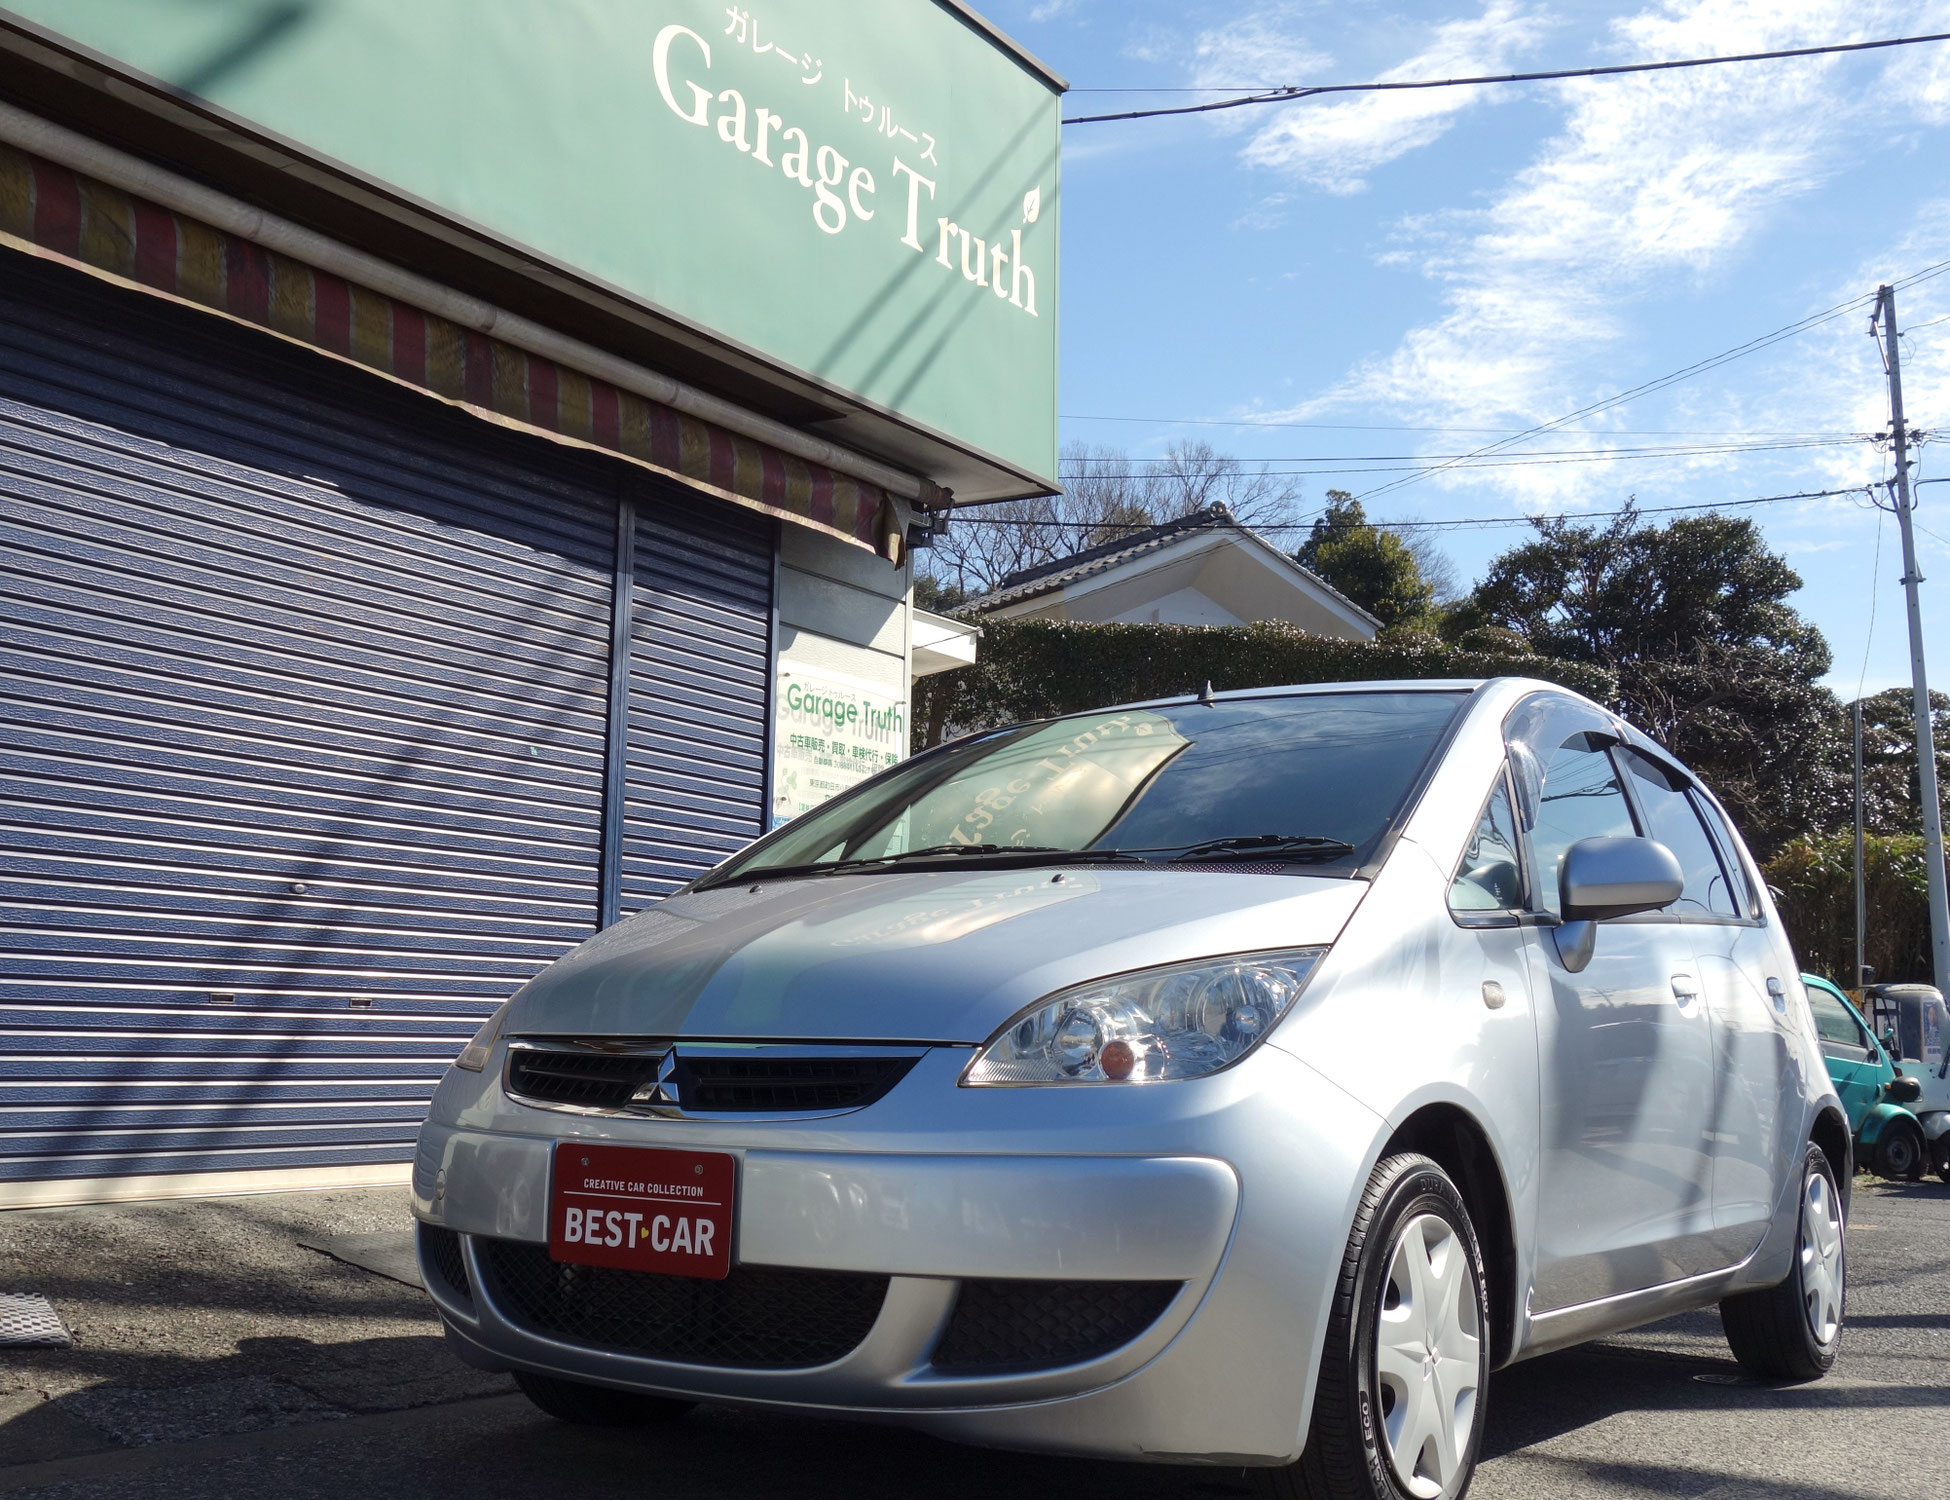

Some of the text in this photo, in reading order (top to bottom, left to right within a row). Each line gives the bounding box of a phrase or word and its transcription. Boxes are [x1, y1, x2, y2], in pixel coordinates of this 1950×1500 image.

[724, 5, 938, 167] ガレージ トゥルース
[652, 24, 1039, 318] Garage Truth
[787, 683, 902, 733] Garage Truth
[583, 1178, 704, 1197] CREATIVE CAR COLLECTION
[564, 1207, 715, 1256] BEST CAR
[1361, 1401, 1374, 1441] ECO
